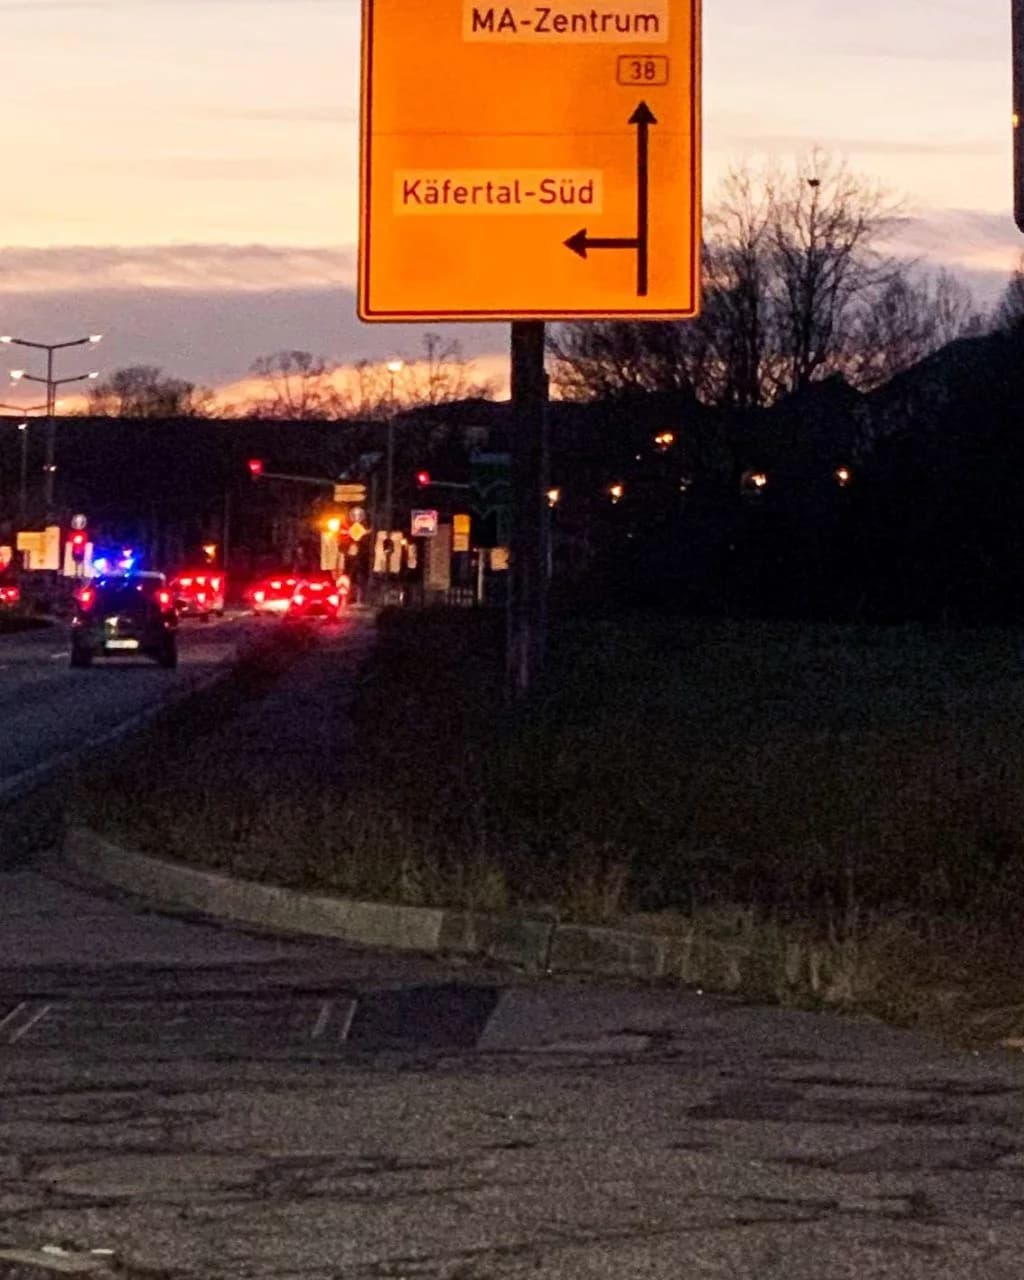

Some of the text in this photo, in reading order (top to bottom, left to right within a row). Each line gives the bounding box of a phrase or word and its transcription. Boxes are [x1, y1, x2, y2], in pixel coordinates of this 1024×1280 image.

[471, 8, 660, 33] MA-Zentrum
[630, 61, 656, 80] 38
[403, 179, 594, 204] Käfertal-Süd
